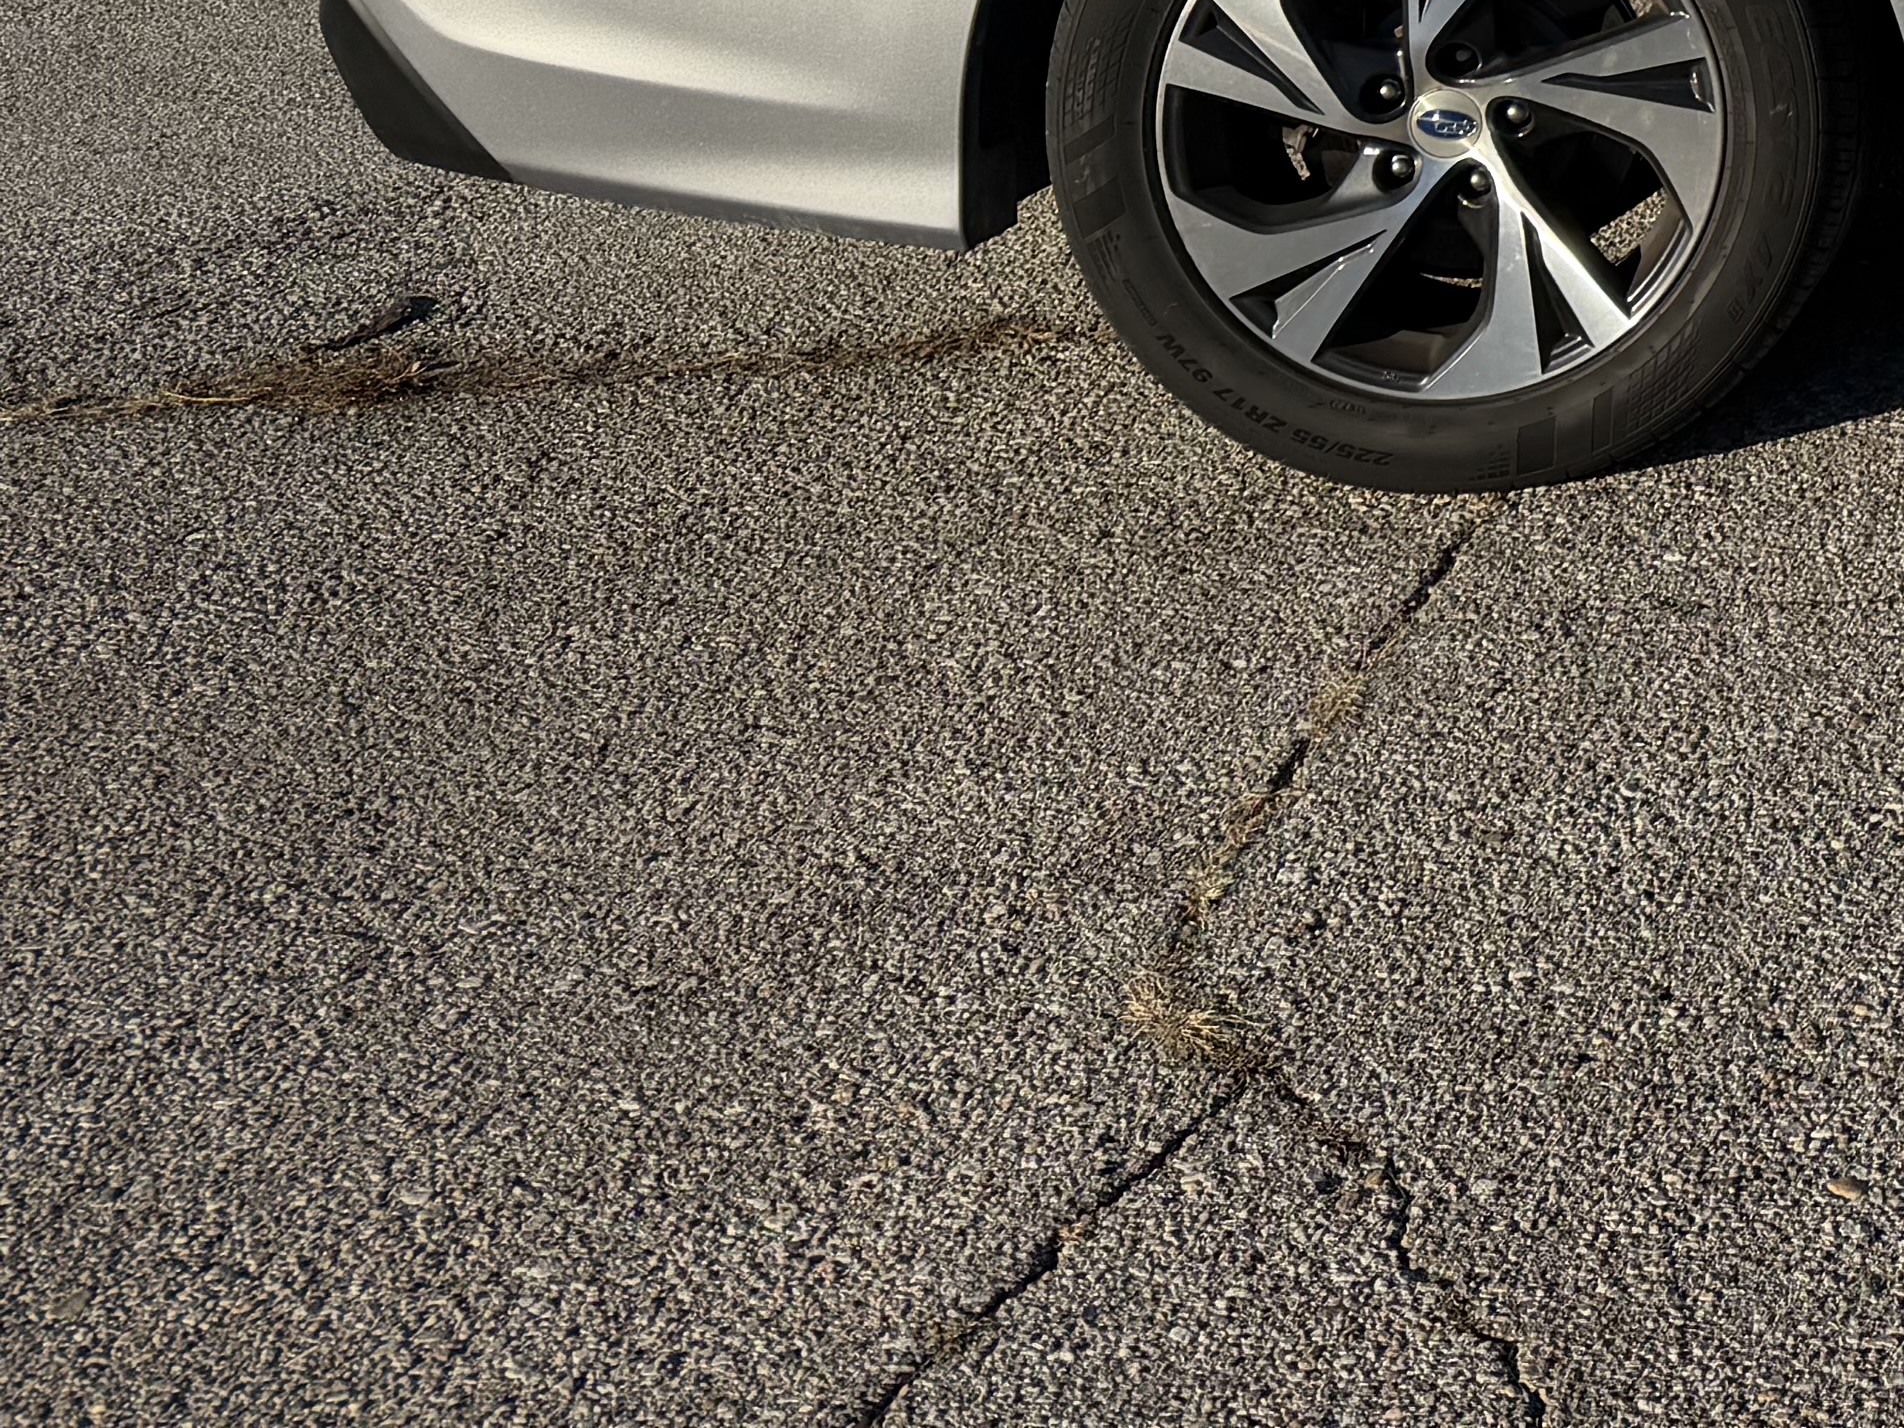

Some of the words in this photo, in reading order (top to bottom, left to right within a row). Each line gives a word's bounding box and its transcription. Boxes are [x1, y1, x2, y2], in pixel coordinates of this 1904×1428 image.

[1155, 333, 1214, 385] 97W
[1212, 387, 1288, 434] ZR17
[1289, 427, 1394, 467] 225/55
